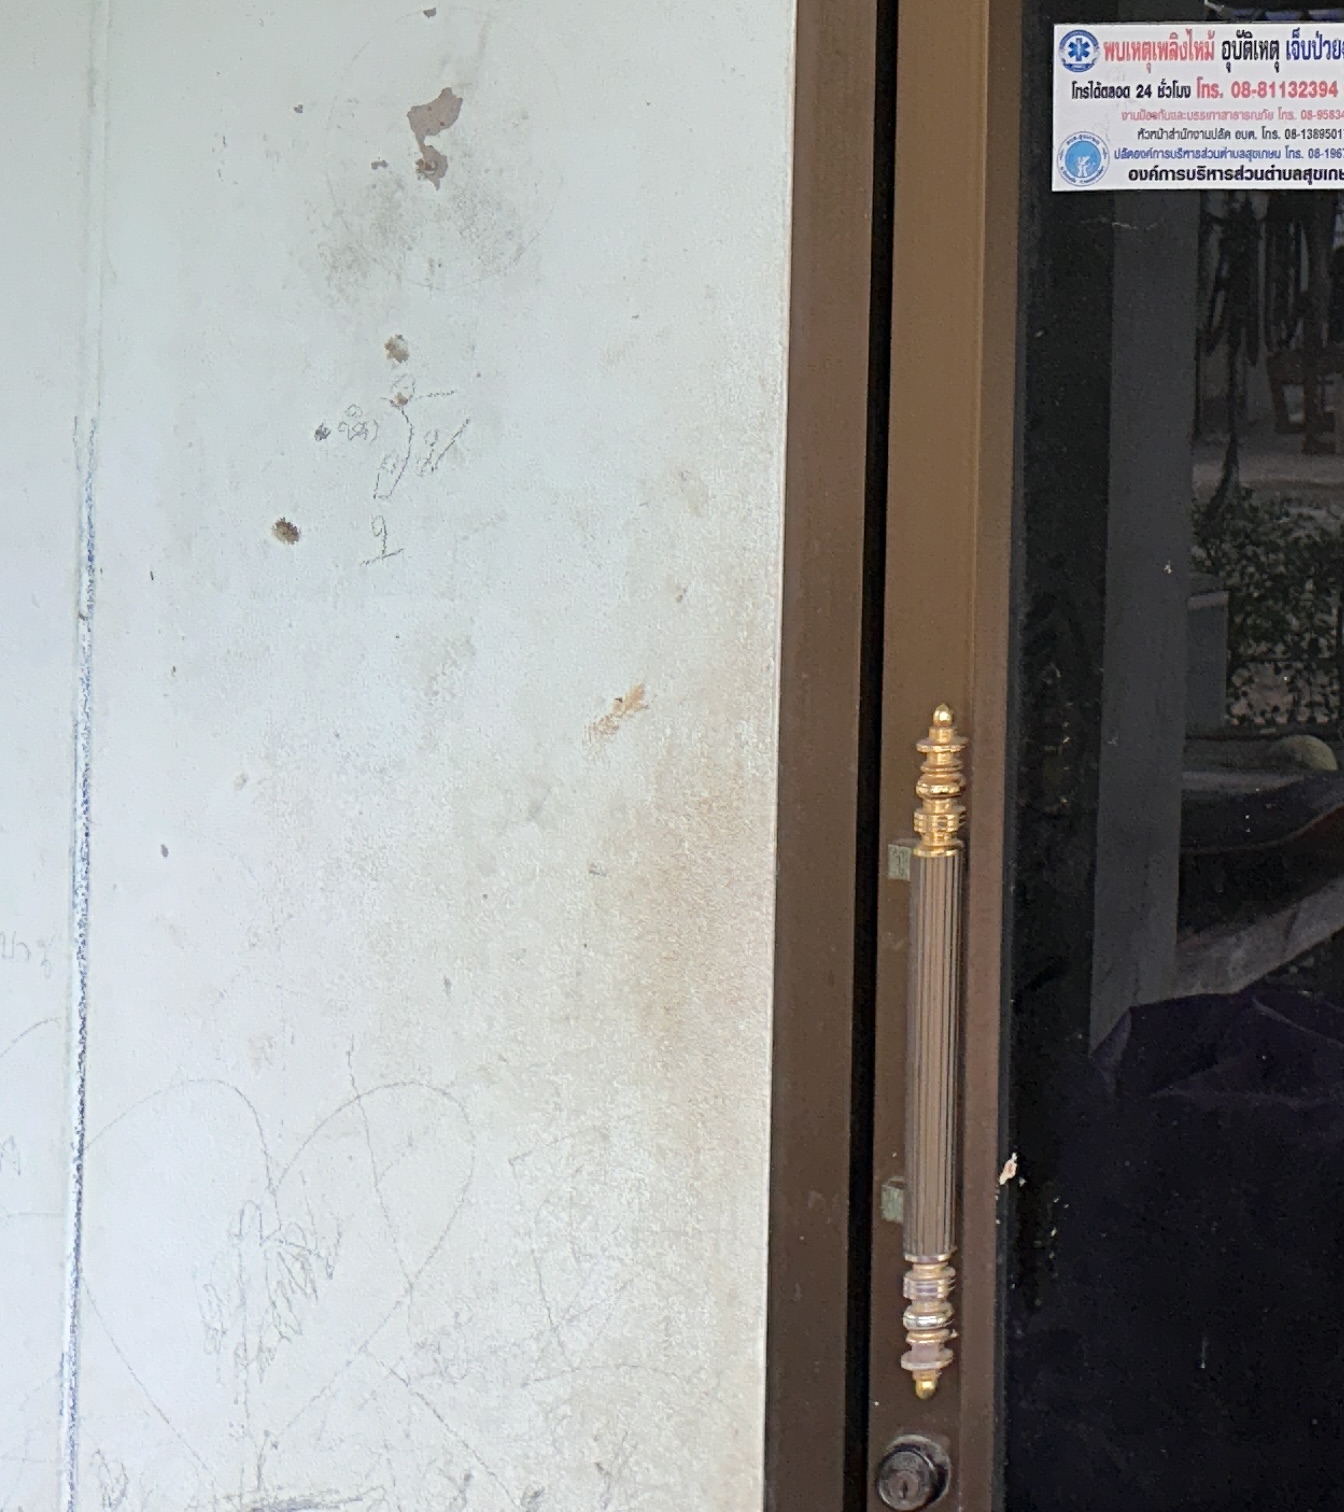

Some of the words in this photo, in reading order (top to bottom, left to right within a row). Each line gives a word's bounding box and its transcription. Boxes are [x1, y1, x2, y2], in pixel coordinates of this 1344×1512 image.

[1103, 29, 1216, 73] พบเหตุเพลิงไหม้
[1221, 29, 1280, 73] อุบัติเหตุ
[1136, 84, 1152, 99] 24
[1157, 78, 1192, 99] ชั่วโมง
[1196, 76, 1224, 99] โทร.
[1231, 80, 1339, 99] 08-81132394
